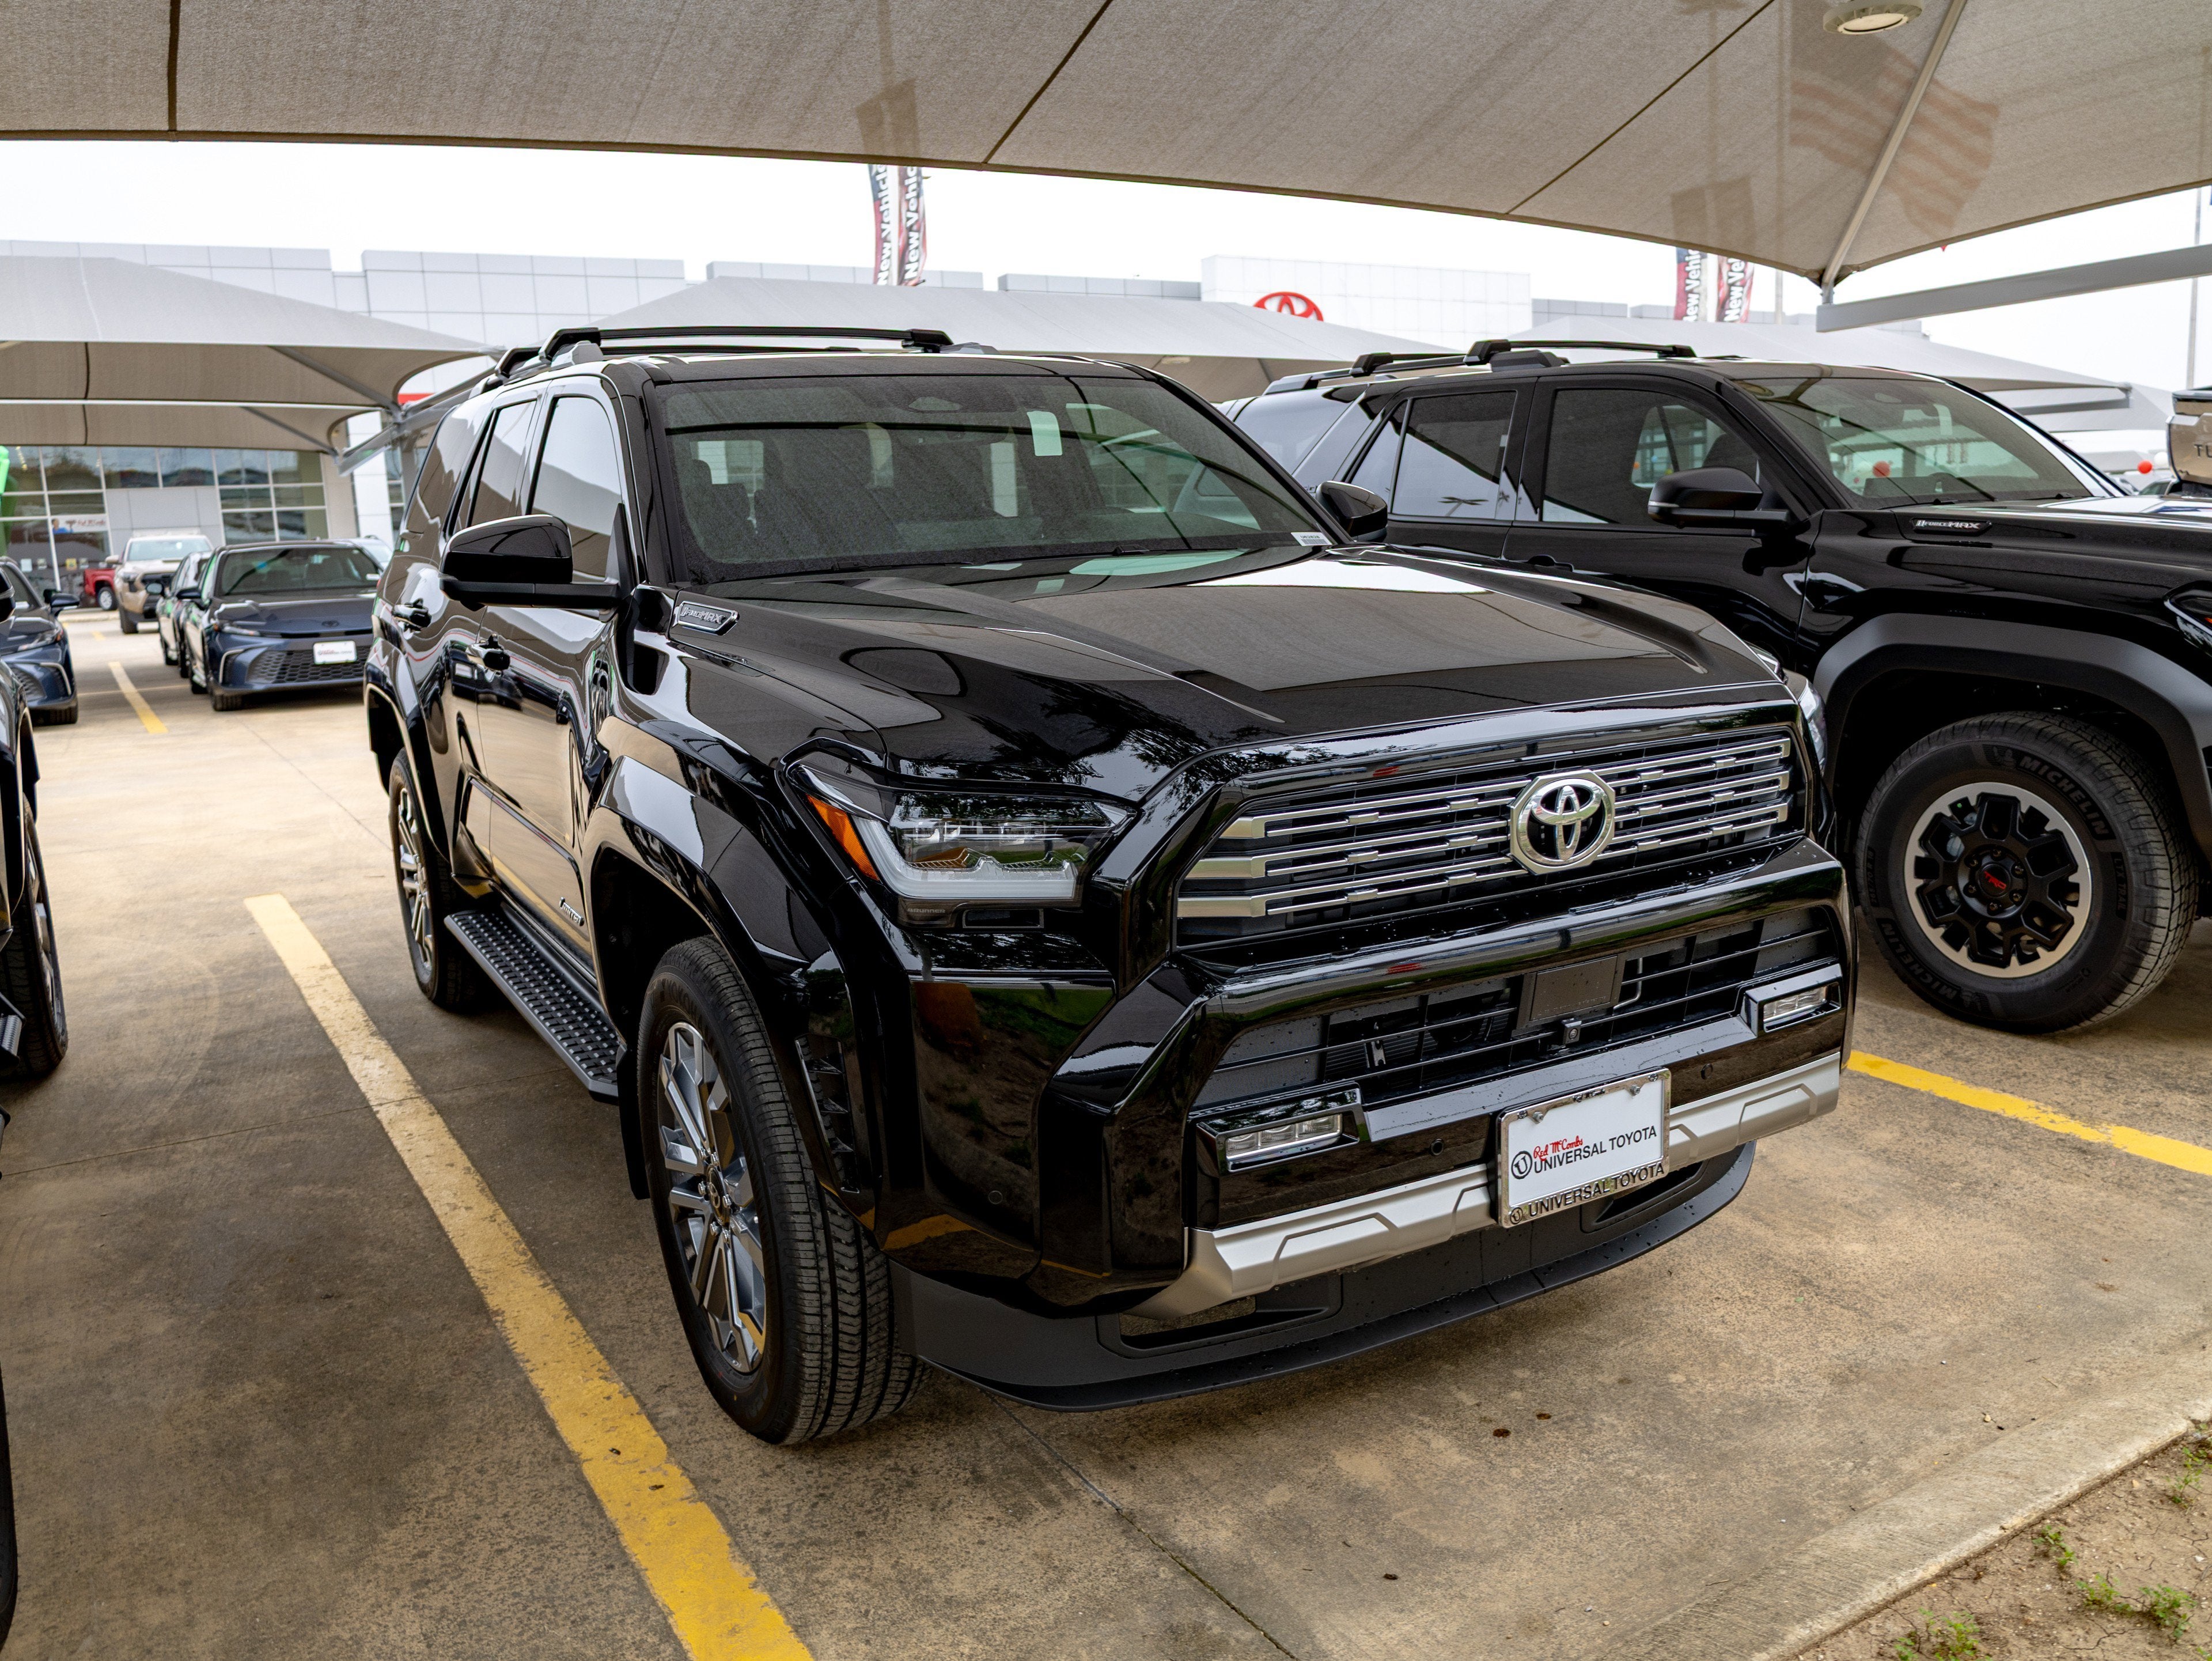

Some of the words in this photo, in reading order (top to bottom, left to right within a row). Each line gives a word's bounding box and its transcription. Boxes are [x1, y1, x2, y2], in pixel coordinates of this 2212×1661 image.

[877, 242, 892, 285] New
[904, 231, 920, 280] New
[1724, 286, 1744, 321] New
[2020, 755, 2111, 835] MICHELIN
[1984, 871, 2007, 890] TRD
[2114, 858, 2126, 878] LTX
[2116, 883, 2127, 911] TRAIL
[1881, 923, 1959, 1000] MICHELIN
[1533, 1144, 1548, 1161] Red
[1534, 1141, 1607, 1174] UNIVERSAL
[1608, 1125, 1657, 1150] TOYOTA
[1528, 1179, 1610, 1217] UNIVERSAL
[1611, 1161, 1664, 1189] TOYOTA
